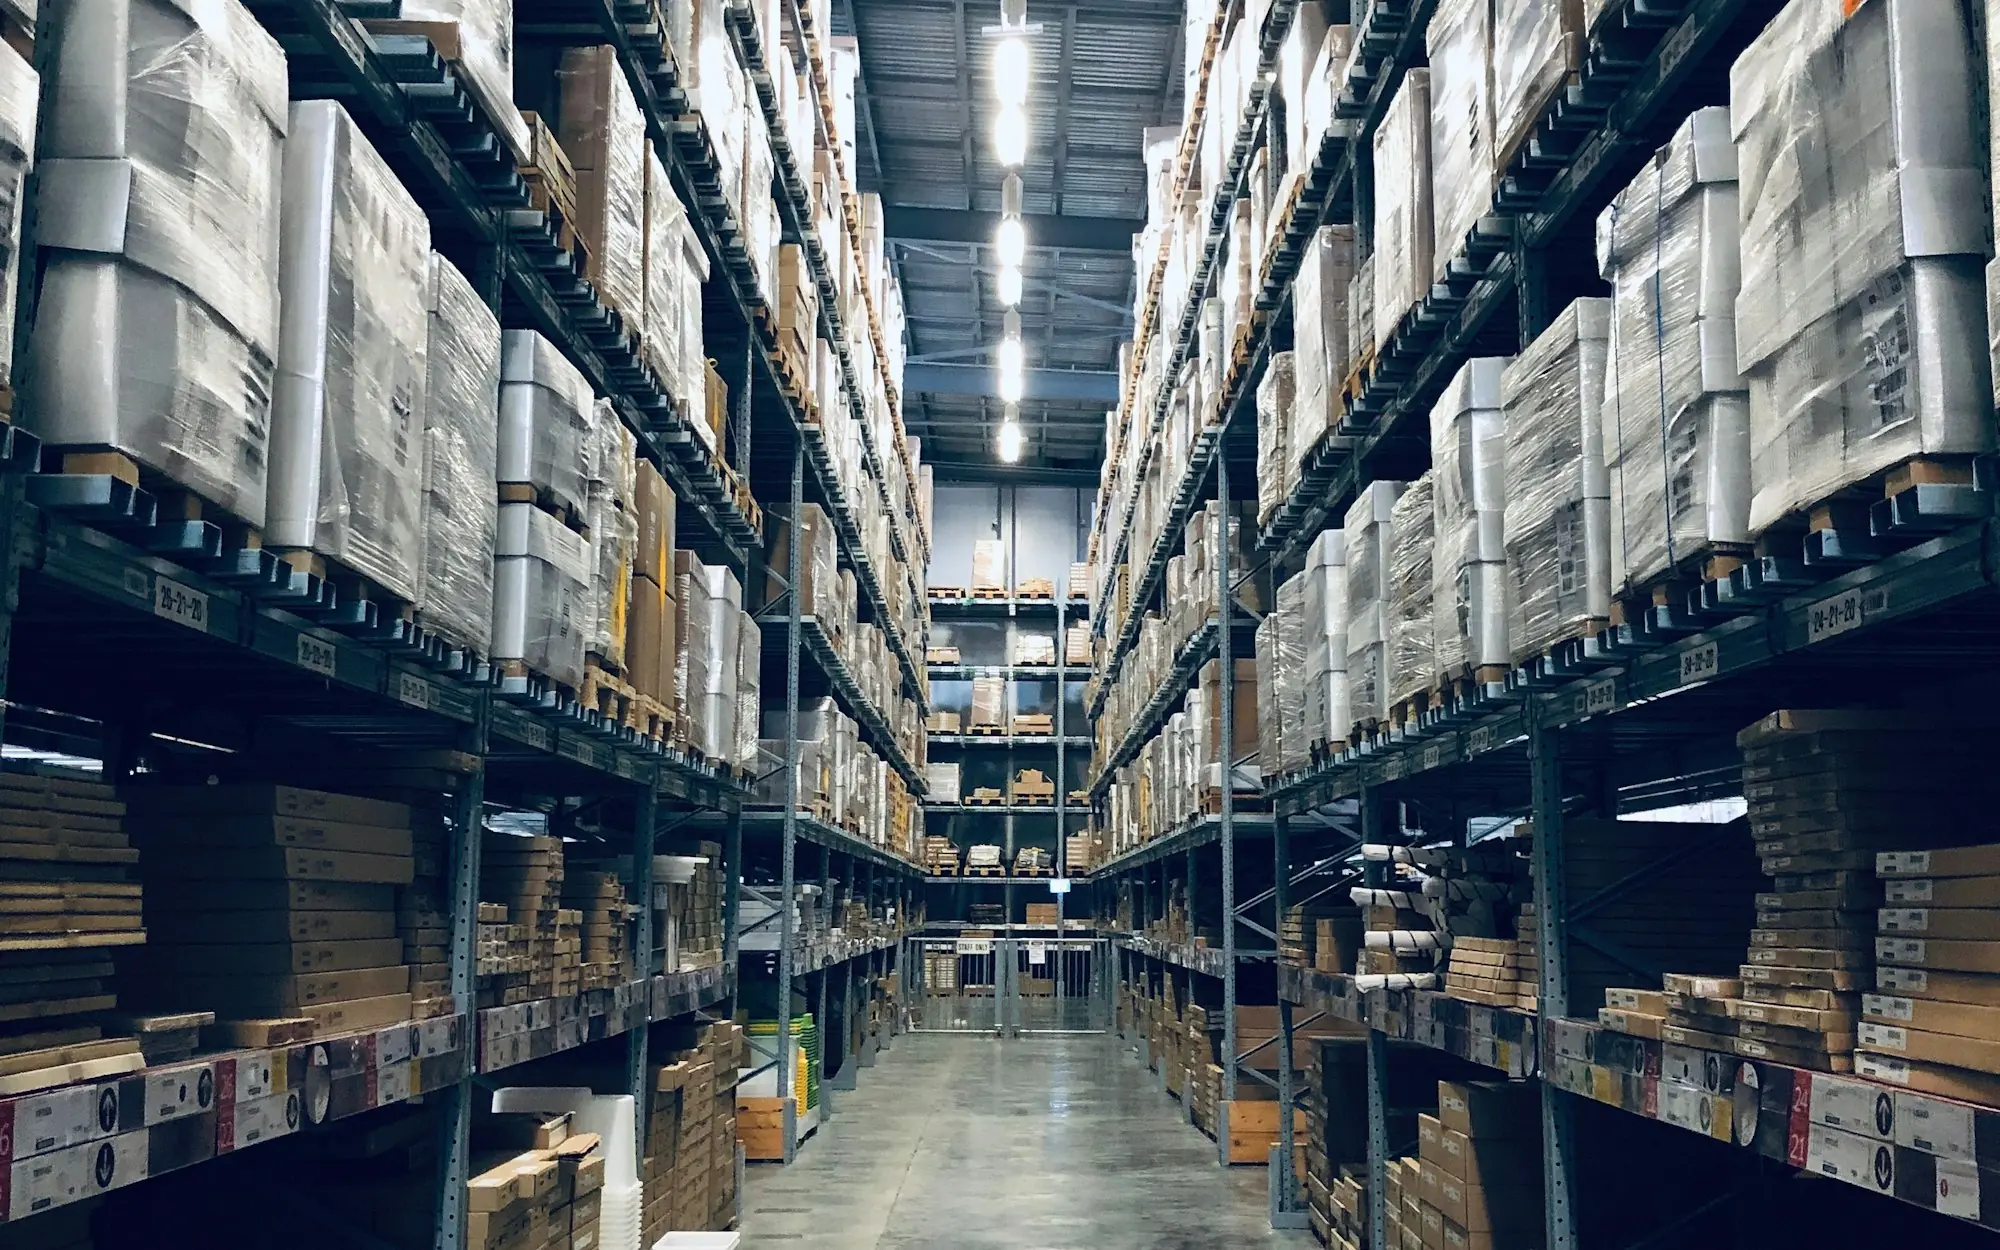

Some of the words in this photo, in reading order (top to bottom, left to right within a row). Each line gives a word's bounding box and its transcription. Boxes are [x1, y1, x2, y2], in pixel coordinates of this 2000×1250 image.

[958, 943, 973, 951] STAFF
[975, 943, 988, 951] ONLY
[1793, 1086, 1808, 1112] 24
[1790, 1133, 1805, 1162] 21
